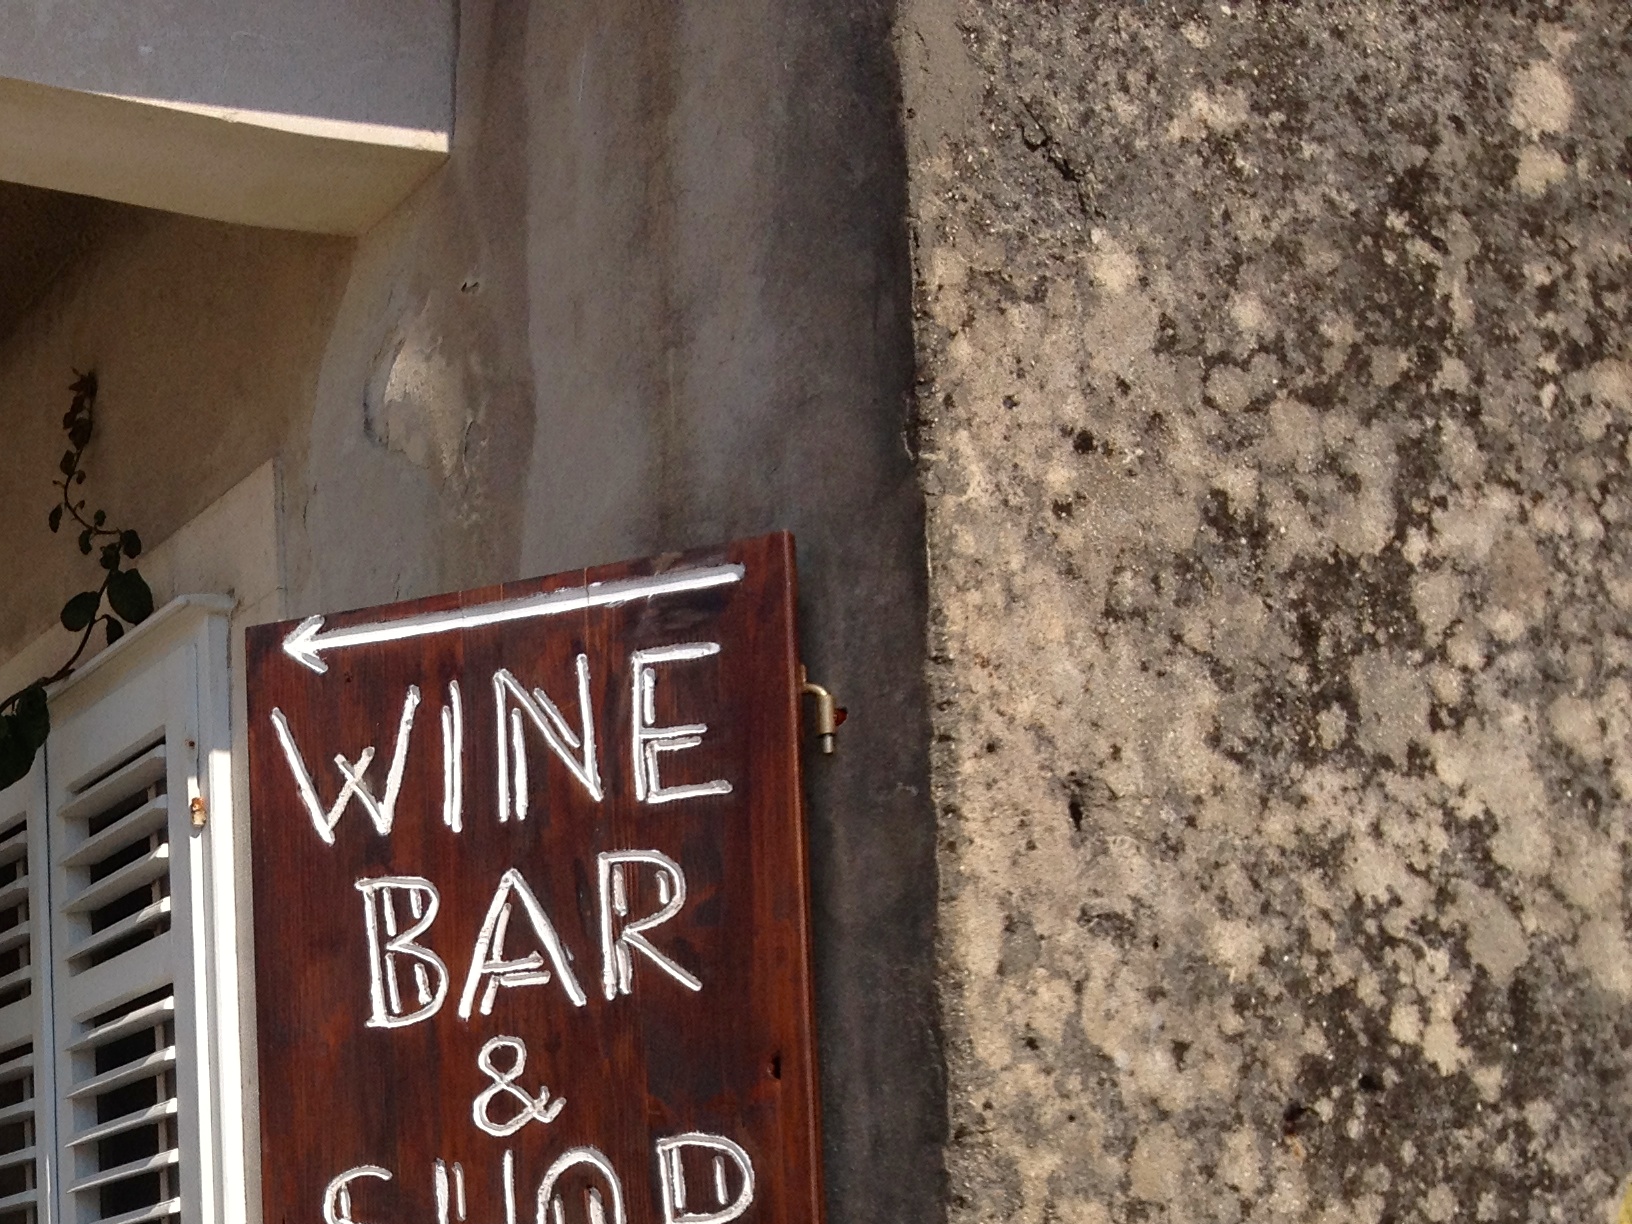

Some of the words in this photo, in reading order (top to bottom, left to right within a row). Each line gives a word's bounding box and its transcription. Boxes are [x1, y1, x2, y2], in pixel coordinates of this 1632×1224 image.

[270, 641, 734, 846] WINE
[353, 849, 703, 1030] BAR
[472, 1034, 567, 1137] &
